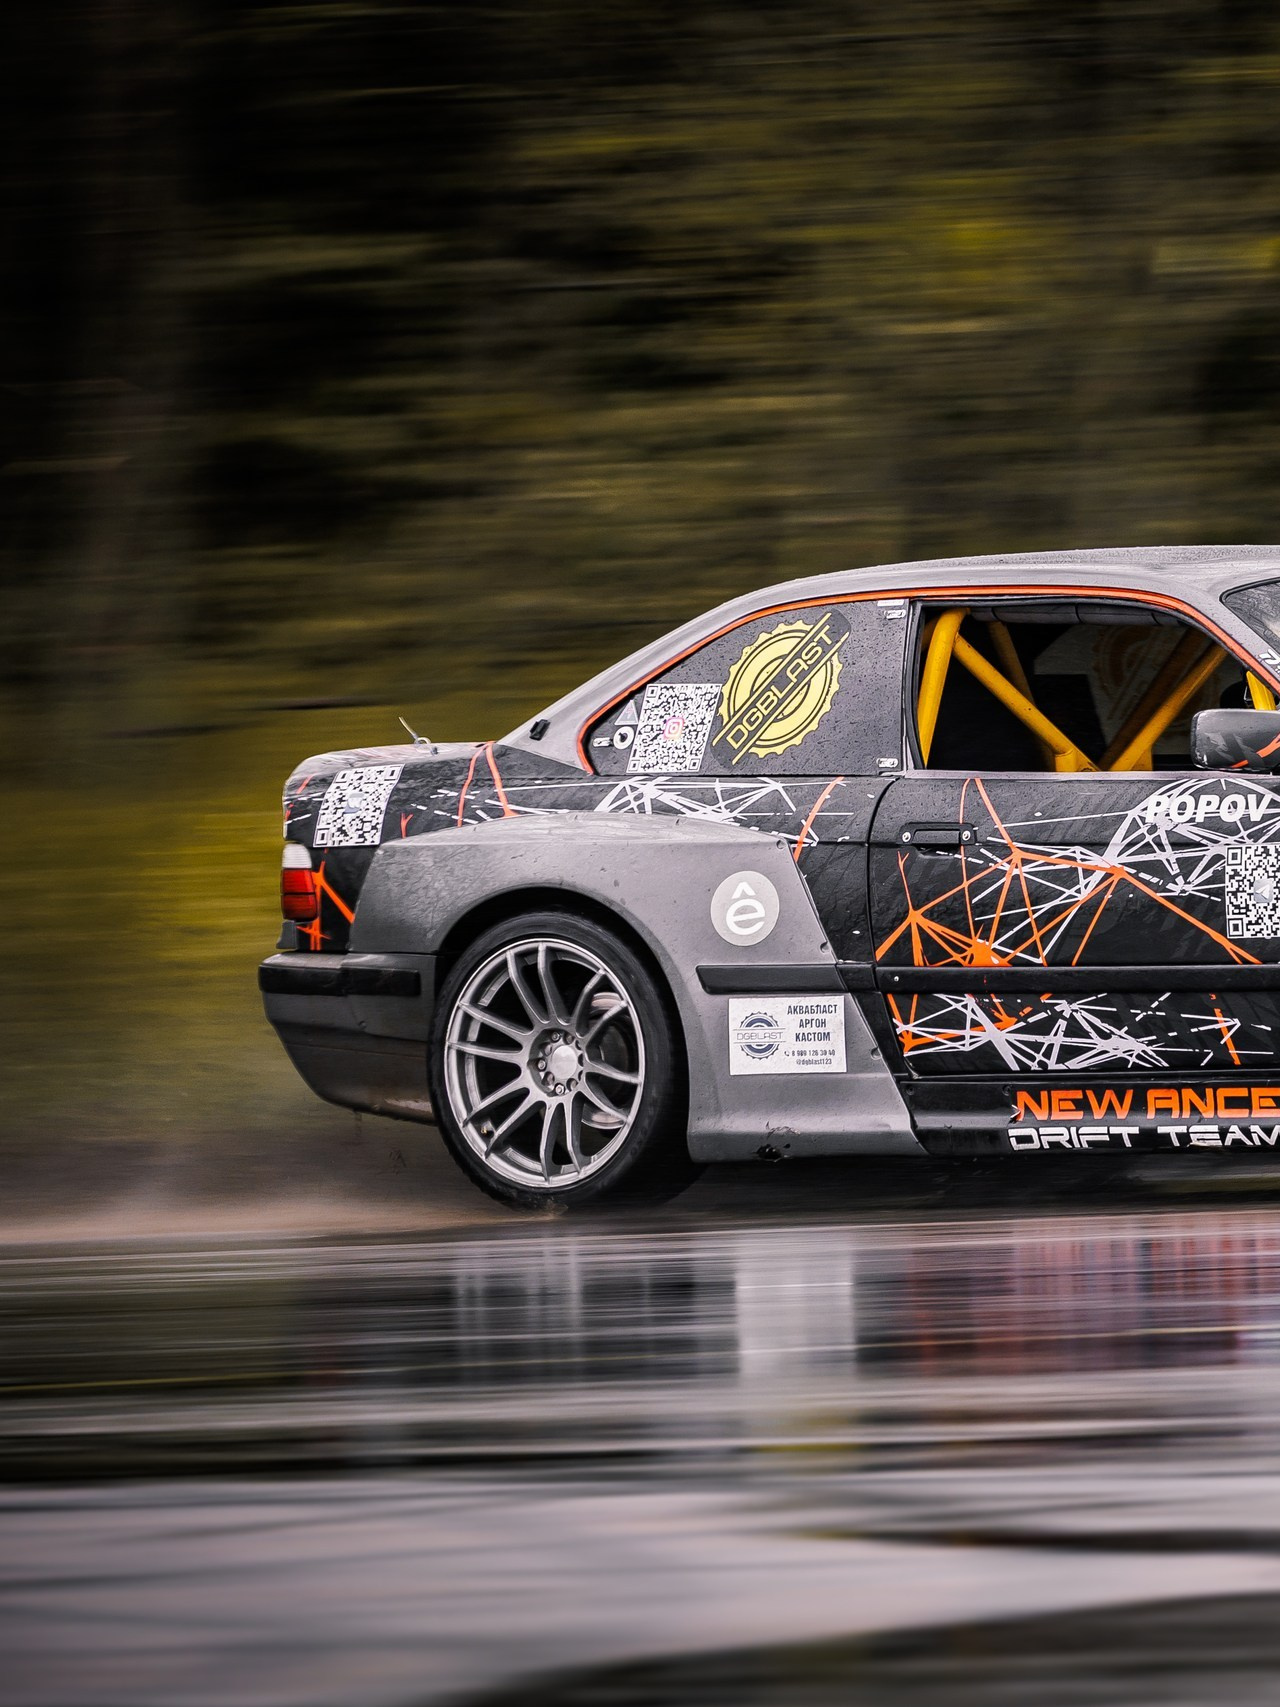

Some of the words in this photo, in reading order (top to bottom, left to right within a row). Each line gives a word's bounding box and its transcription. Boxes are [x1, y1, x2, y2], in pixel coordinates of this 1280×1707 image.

[726, 625, 833, 750] DGBLAST
[1146, 793, 1272, 823] POPOV
[787, 1004, 838, 1015] АКВАБЛАСТ
[799, 1018, 827, 1029] АРГОН
[737, 1032, 783, 1041] DGBLAST
[795, 1032, 831, 1042] КАСТОМ
[1016, 1089, 1134, 1121] NEW
[1008, 1126, 1140, 1150] DRIFT
